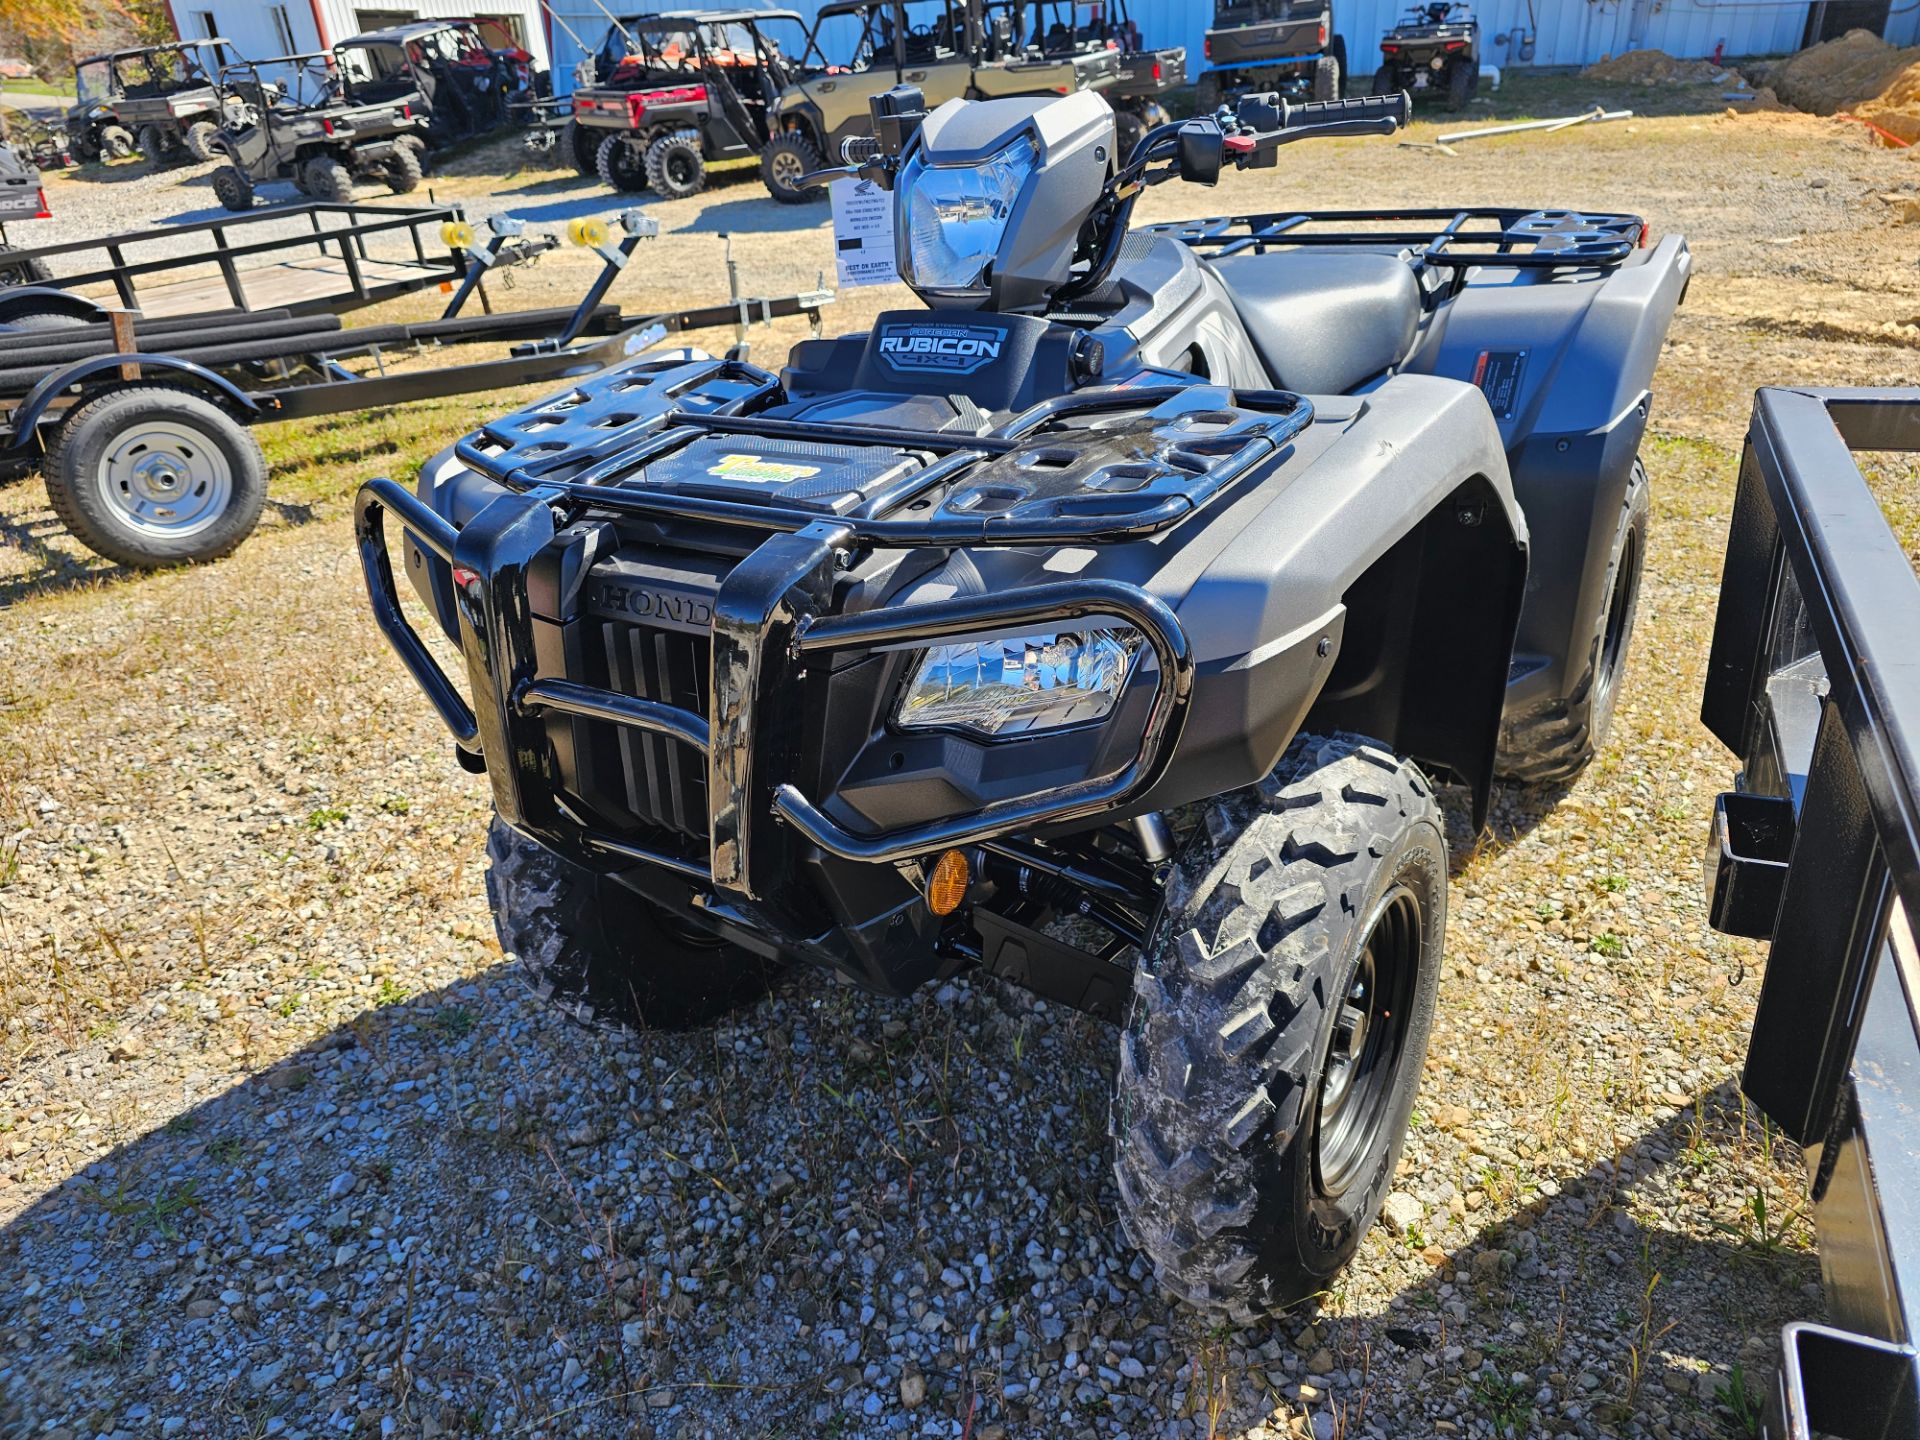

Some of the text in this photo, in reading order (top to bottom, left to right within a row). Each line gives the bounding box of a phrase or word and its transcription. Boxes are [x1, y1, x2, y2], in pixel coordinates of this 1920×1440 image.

[0, 199, 38, 210] RCE
[909, 328, 968, 337] FOREMAN
[879, 337, 1001, 358] RUBICON
[600, 584, 712, 627] HOND
